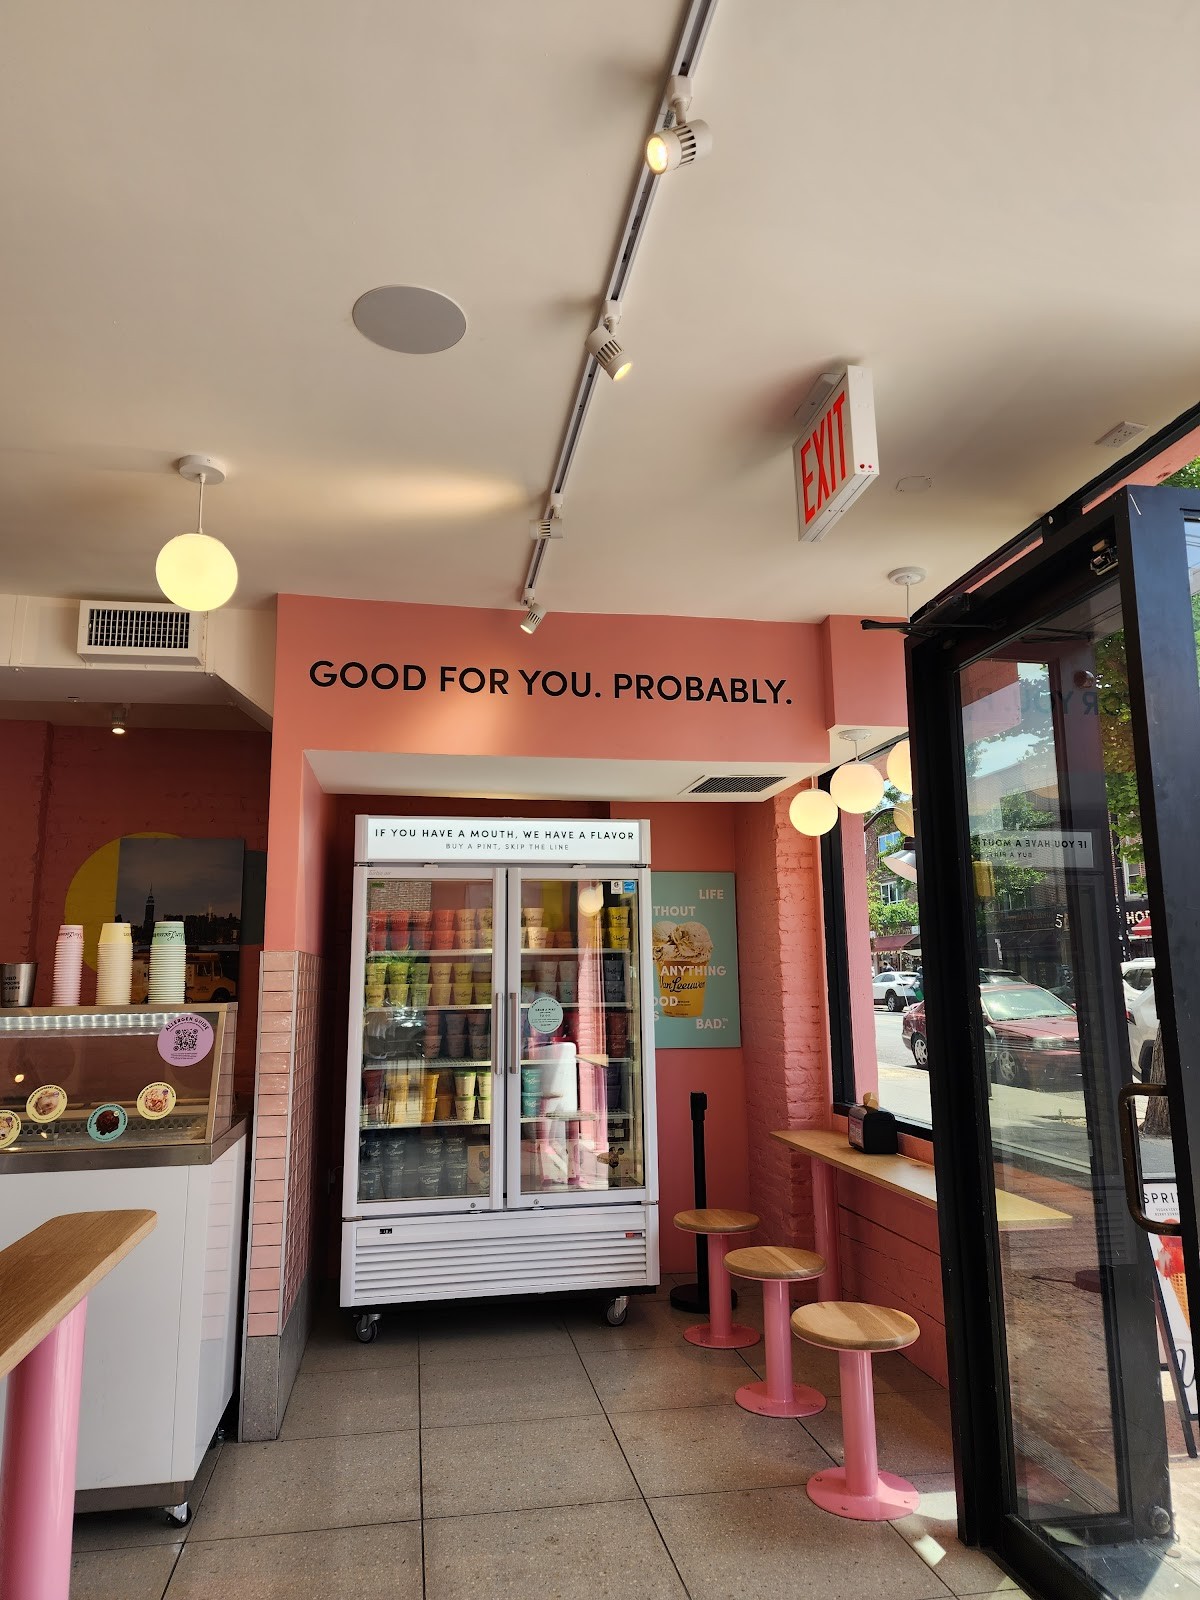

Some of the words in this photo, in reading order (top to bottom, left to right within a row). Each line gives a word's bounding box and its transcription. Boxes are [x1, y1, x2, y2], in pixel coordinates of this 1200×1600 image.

[800, 390, 846, 525] EXIT
[309, 660, 427, 691] GOOD
[440, 665, 509, 695] FOR
[518, 669, 601, 698] YOU.
[614, 673, 792, 705] PROBABLY.
[375, 828, 386, 837] IF
[391, 828, 416, 837] YOU
[422, 829, 453, 838] HAVE
[458, 829, 465, 838] A
[470, 830, 518, 839] MOUTH,
[523, 830, 539, 839] WE
[545, 831, 574, 839] HAVE
[579, 831, 586, 839] A
[590, 831, 634, 840] FLAVOR
[477, 843, 501, 851] PINT,
[699, 889, 724, 900] LIFE
[660, 965, 727, 977] ANYTHING
[165, 1016, 194, 1032] ALLERGEN
[194, 1017, 210, 1031] GUIDE
[1143, 1192, 1178, 1204] SPRI
